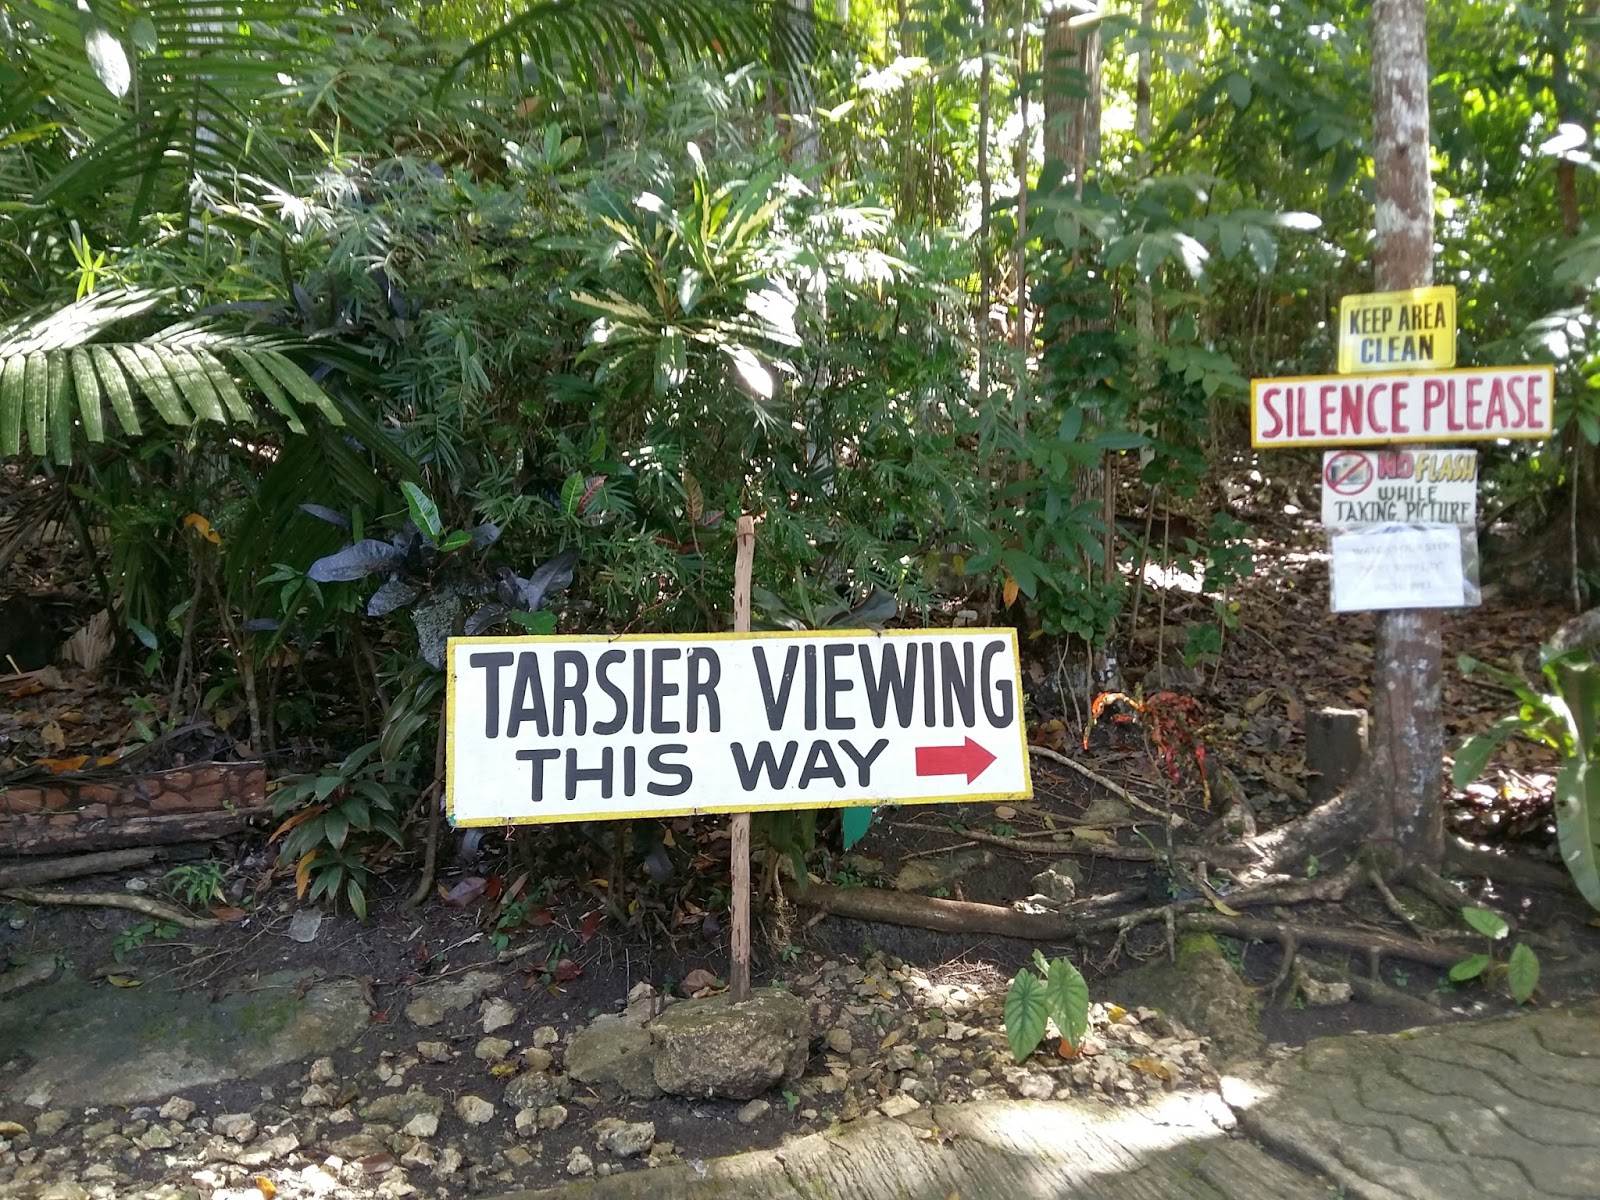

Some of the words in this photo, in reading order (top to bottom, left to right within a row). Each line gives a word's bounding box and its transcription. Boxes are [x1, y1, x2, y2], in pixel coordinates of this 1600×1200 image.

[1350, 307, 1392, 334] KEEP
[1398, 301, 1446, 331] AREA
[1360, 335, 1434, 364] CLEAN
[1262, 382, 1410, 438] SILENCE
[1423, 375, 1543, 431] PLEASE
[1377, 453, 1414, 479] NO
[1415, 453, 1477, 483] FLASH
[1378, 486, 1438, 501] WHILE
[1335, 501, 1397, 522] TAKING
[1406, 502, 1472, 523] PICTURE
[470, 647, 720, 738] TARSIER
[752, 641, 1014, 732] VIEWING
[516, 744, 693, 802] THIS
[730, 738, 889, 791] WAY
